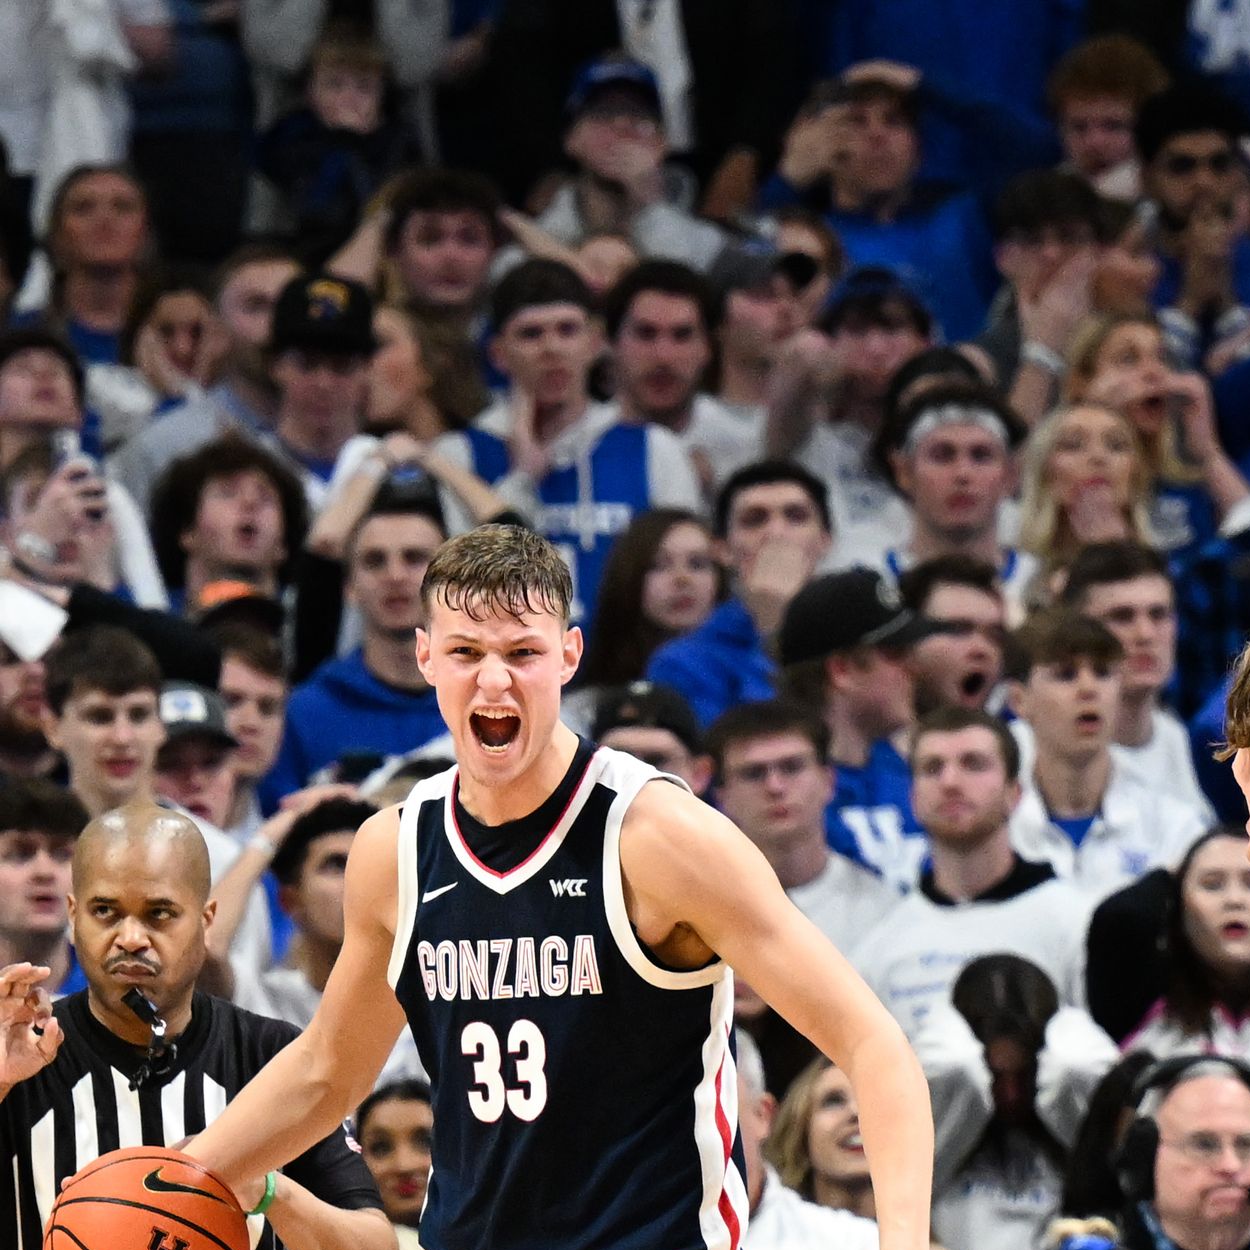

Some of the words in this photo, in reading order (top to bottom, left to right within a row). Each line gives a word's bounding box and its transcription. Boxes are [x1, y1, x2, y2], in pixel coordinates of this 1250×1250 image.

[548, 879, 589, 897] WCC
[417, 934, 602, 1002] GONZAGA
[460, 1018, 547, 1124] 33
